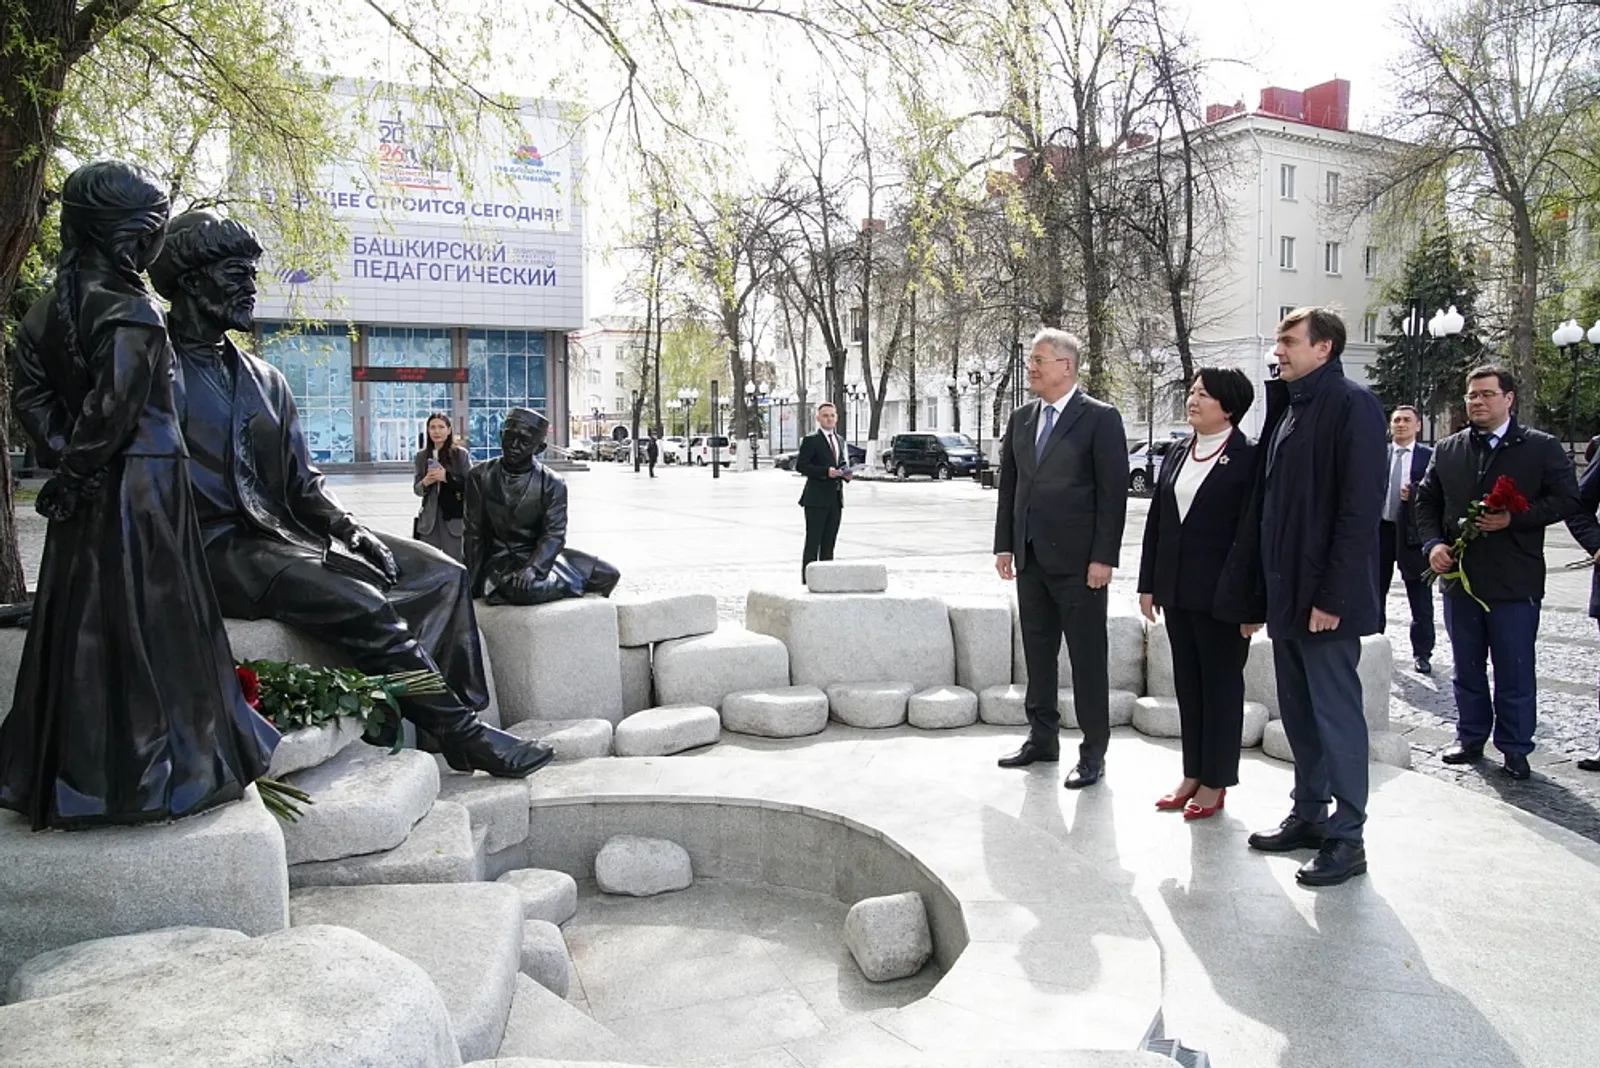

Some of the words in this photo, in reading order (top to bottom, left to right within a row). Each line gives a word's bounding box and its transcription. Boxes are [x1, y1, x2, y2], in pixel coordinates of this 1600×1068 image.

[379, 125, 404, 143] 20
[353, 236, 506, 262] БАШКИРСКИЙ
[353, 259, 556, 287] ПЕДАГОГИЧЕСКИЙ
